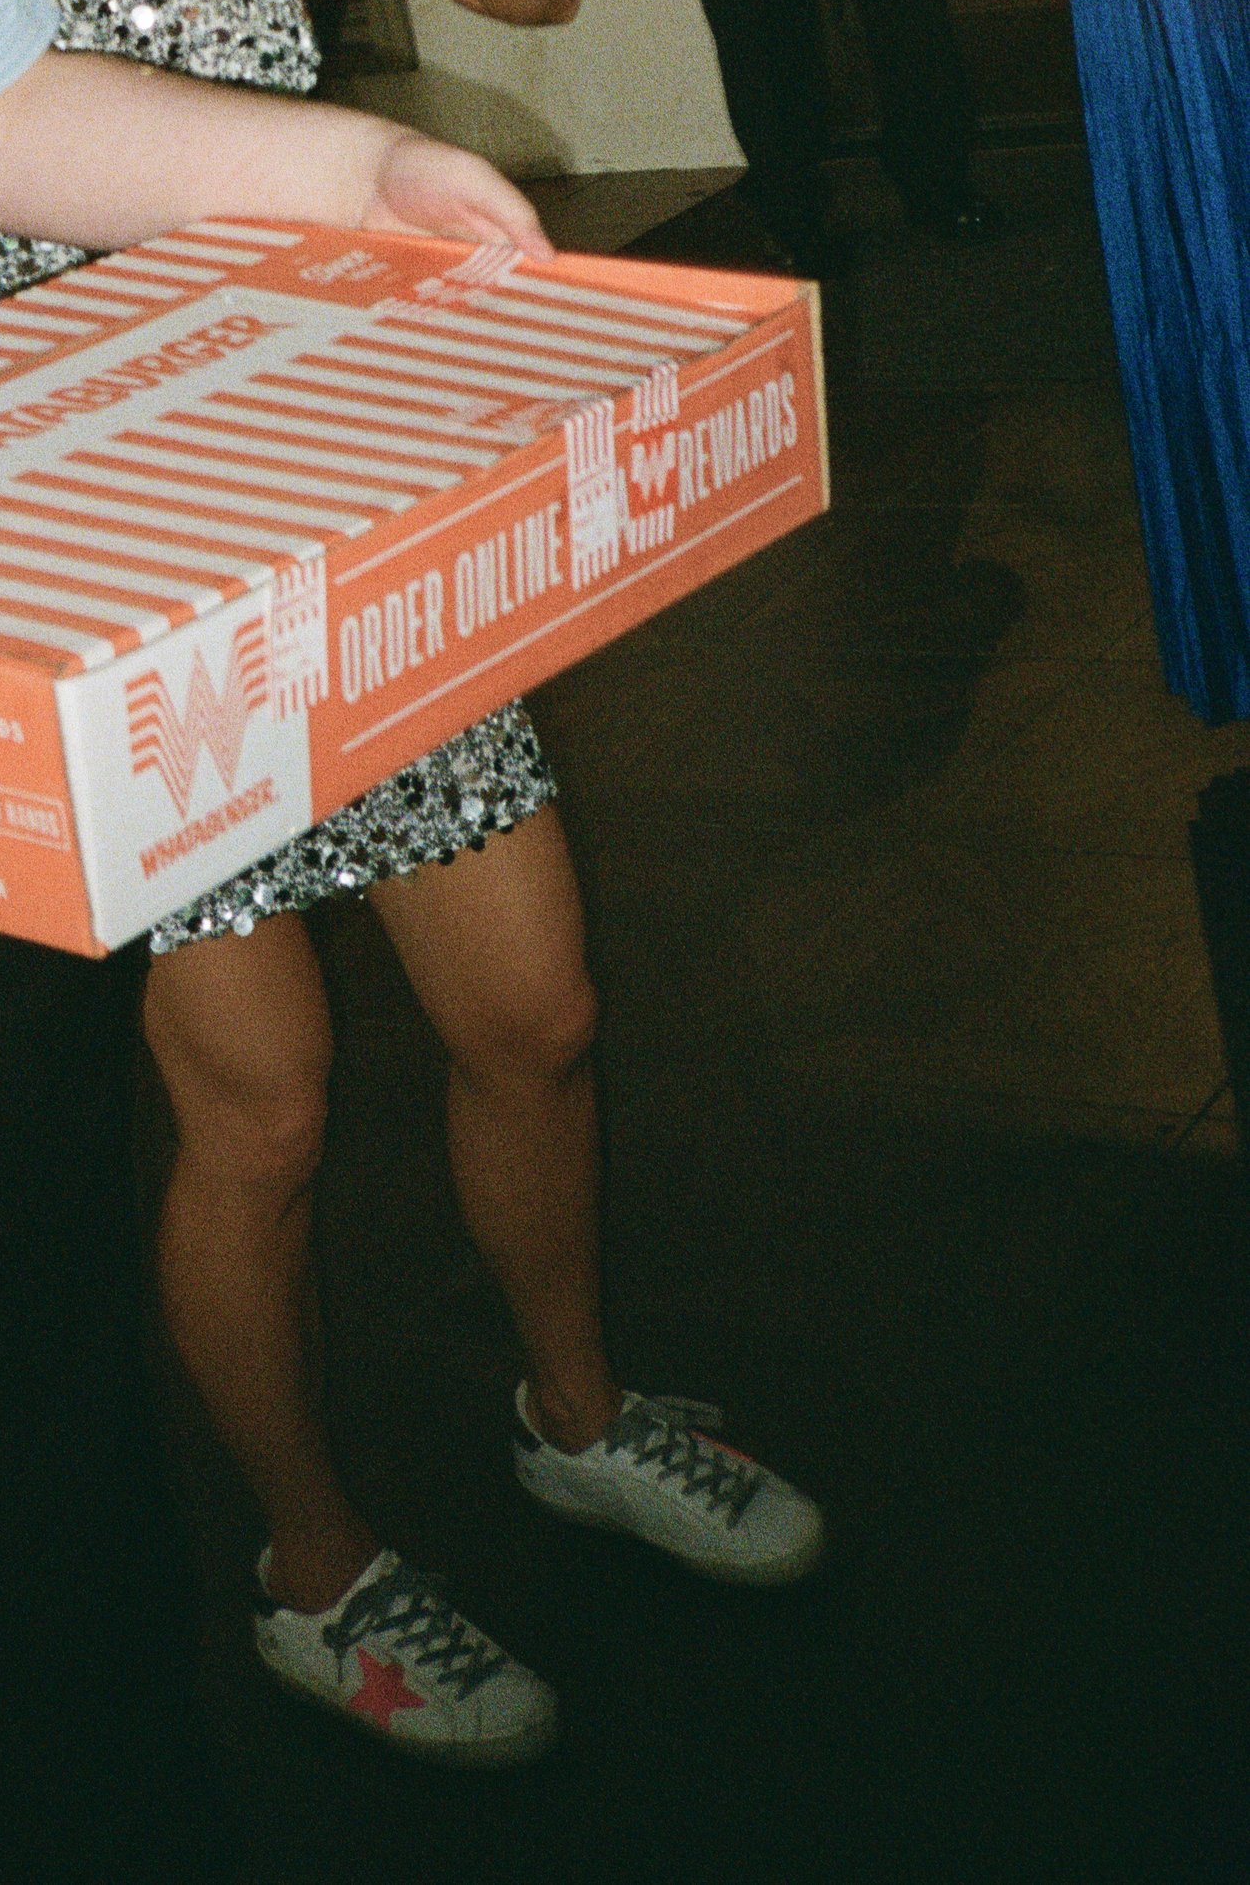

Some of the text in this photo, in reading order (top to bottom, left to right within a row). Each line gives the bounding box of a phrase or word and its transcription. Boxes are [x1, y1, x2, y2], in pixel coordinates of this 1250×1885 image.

[678, 371, 798, 511] REWARDS
[338, 500, 565, 703] ORDER ONLINE
